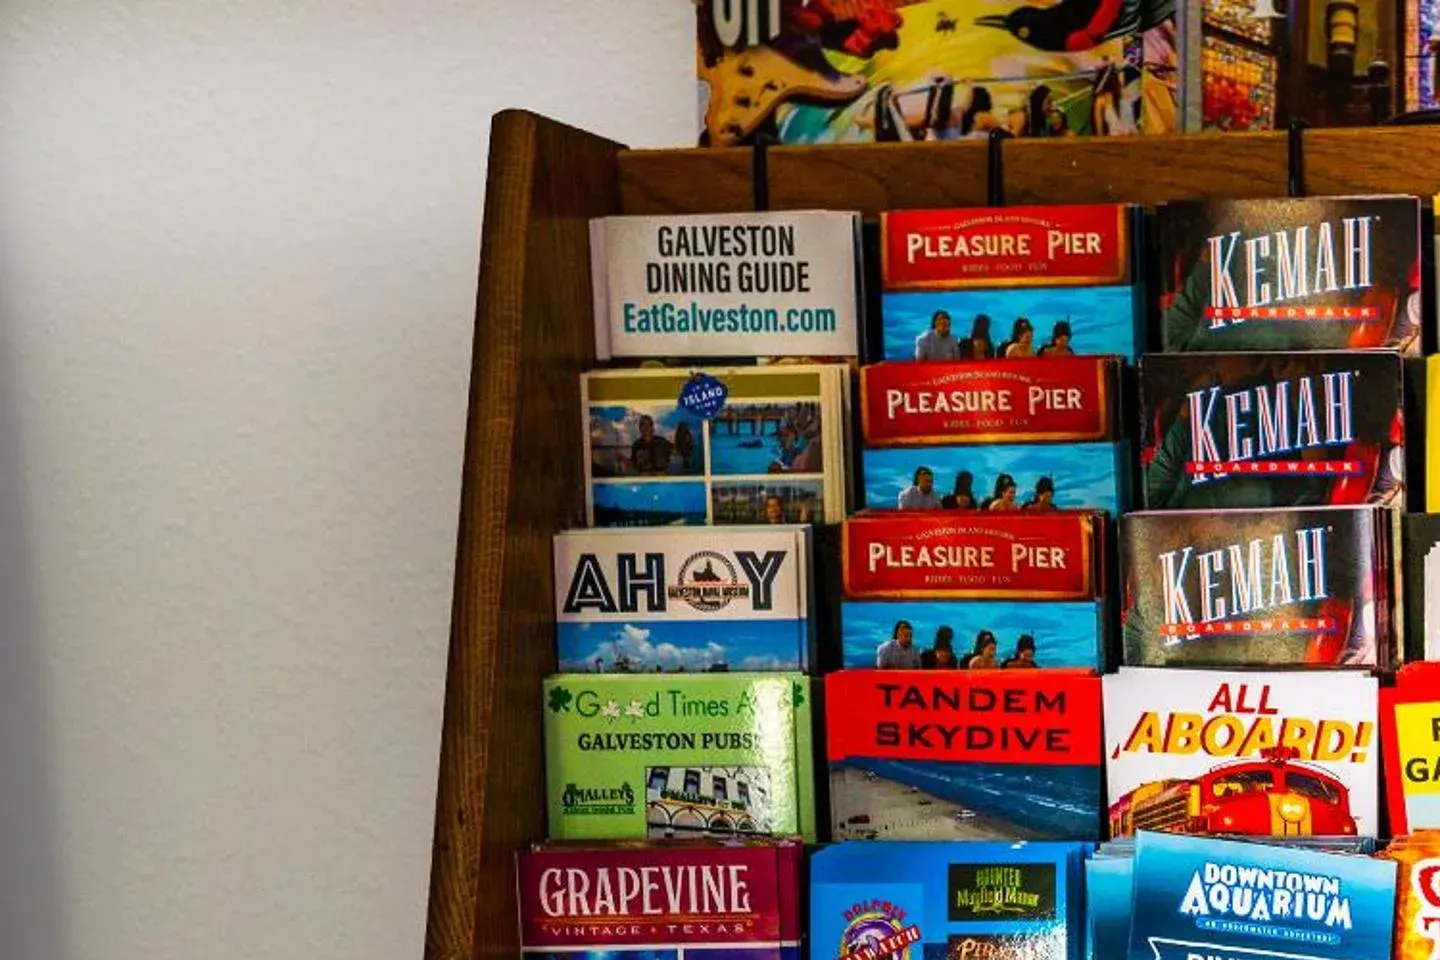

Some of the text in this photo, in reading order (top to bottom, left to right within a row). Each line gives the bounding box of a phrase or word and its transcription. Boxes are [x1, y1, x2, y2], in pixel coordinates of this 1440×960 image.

[658, 225, 794, 258] GALVESTON
[907, 229, 1101, 264] PLEASURE PIER
[1207, 216, 1375, 330] KEMAH
[887, 386, 1082, 418] PLEASURE PIER
[1187, 371, 1356, 484] KEMAH
[868, 541, 1065, 572] PLEASURE PIER
[1207, 683, 1278, 715] ALL
[875, 722, 1070, 752] SKYDIVE
[539, 864, 751, 918] GRAPEVINE
[1204, 862, 1340, 896] DOWNTOWN
[550, 923, 744, 936] VINTAGE TEXAS
